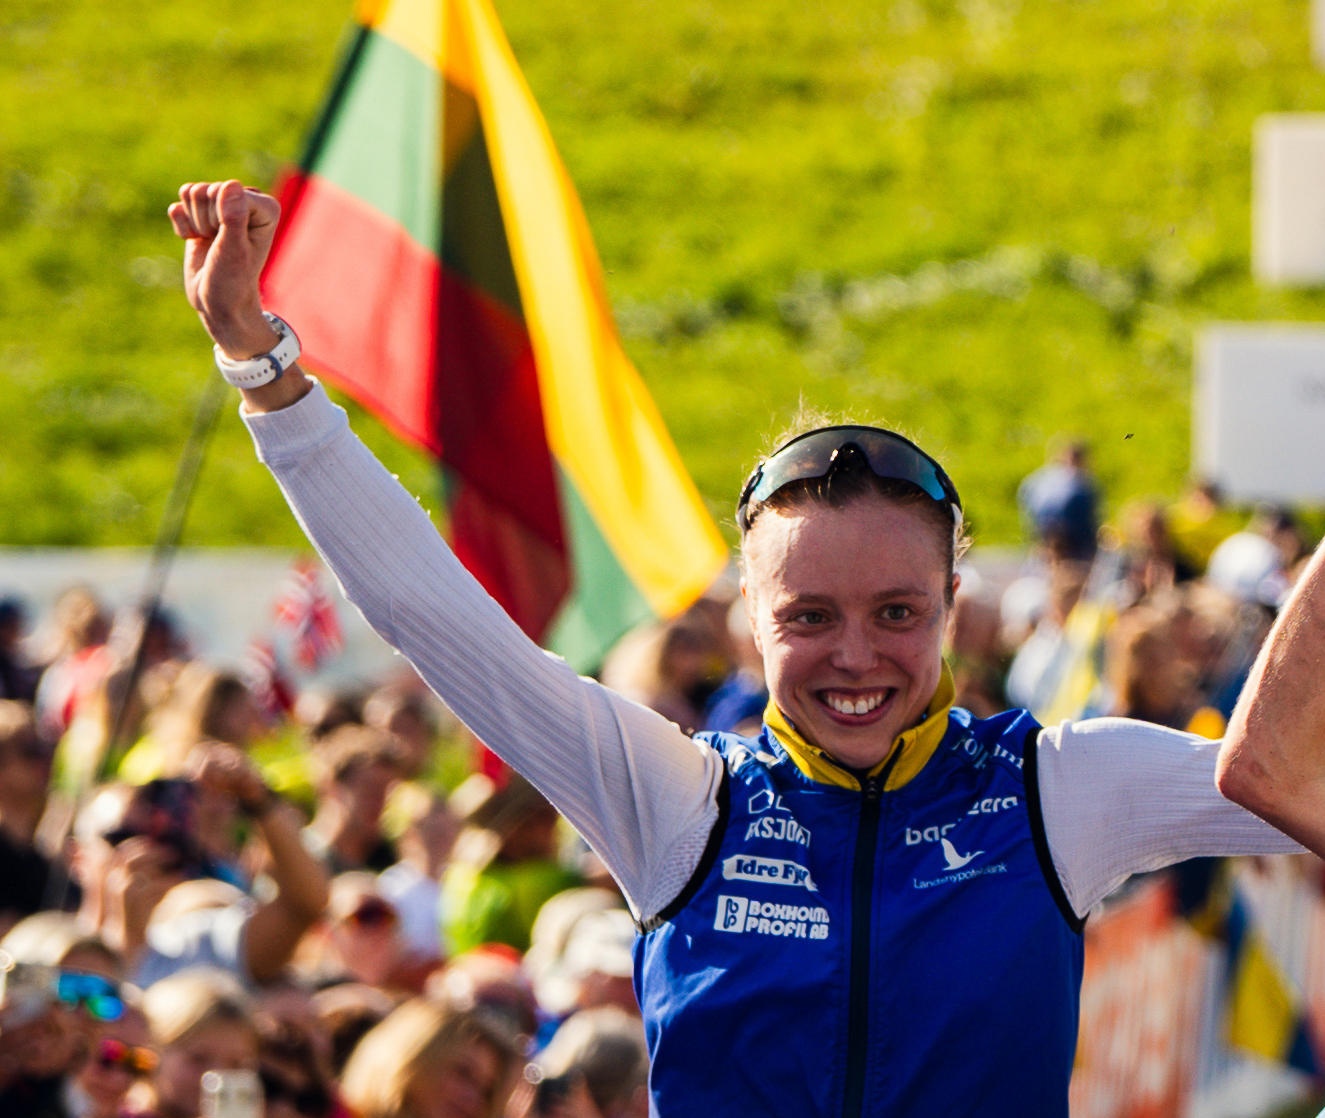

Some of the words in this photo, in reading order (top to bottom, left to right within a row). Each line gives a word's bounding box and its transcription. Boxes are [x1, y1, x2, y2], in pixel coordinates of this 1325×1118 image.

[735, 858, 779, 878] Idre
[745, 915, 806, 938] PROFIL
[809, 922, 830, 940] AB
